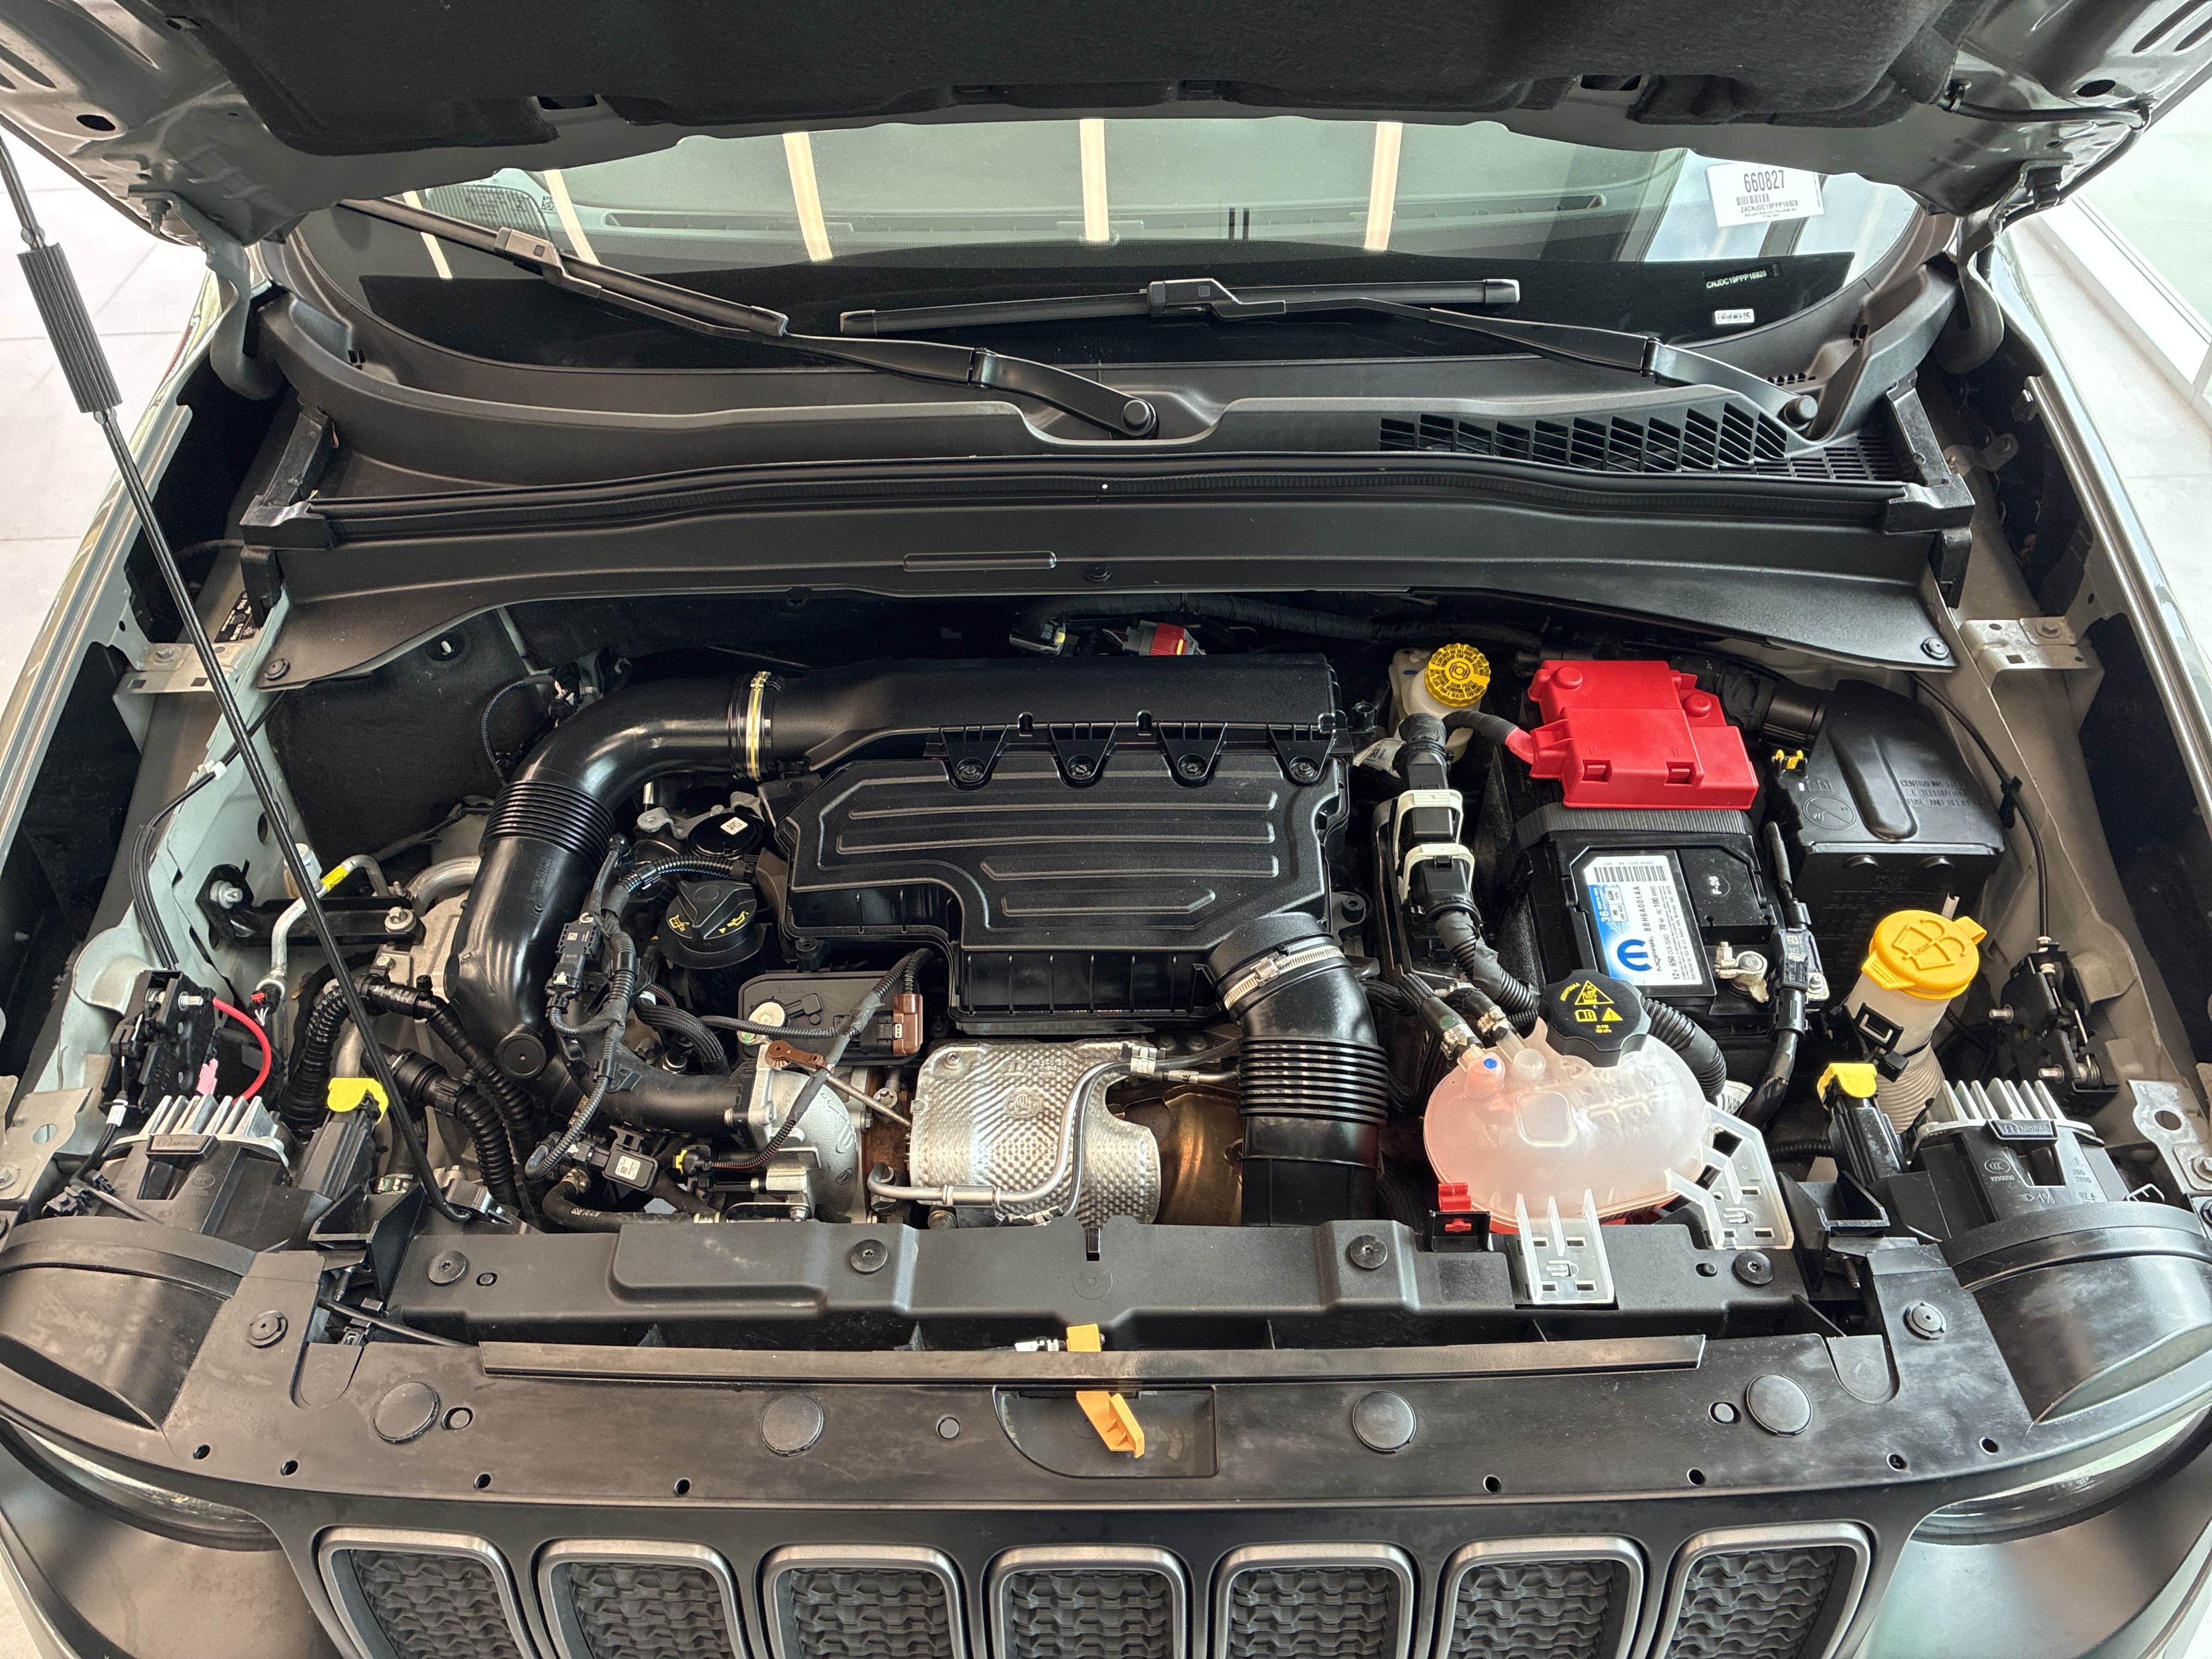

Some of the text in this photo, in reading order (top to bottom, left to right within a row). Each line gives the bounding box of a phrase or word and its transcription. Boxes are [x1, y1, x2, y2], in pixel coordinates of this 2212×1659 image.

[1743, 170, 1785, 193] 660827
[1708, 876, 1722, 895] F-26
[1633, 886, 1651, 932] BBH6A001AA
[1651, 898, 1660, 907] 100
[1599, 911, 1611, 922] 36
[1667, 956, 1677, 966] 650
